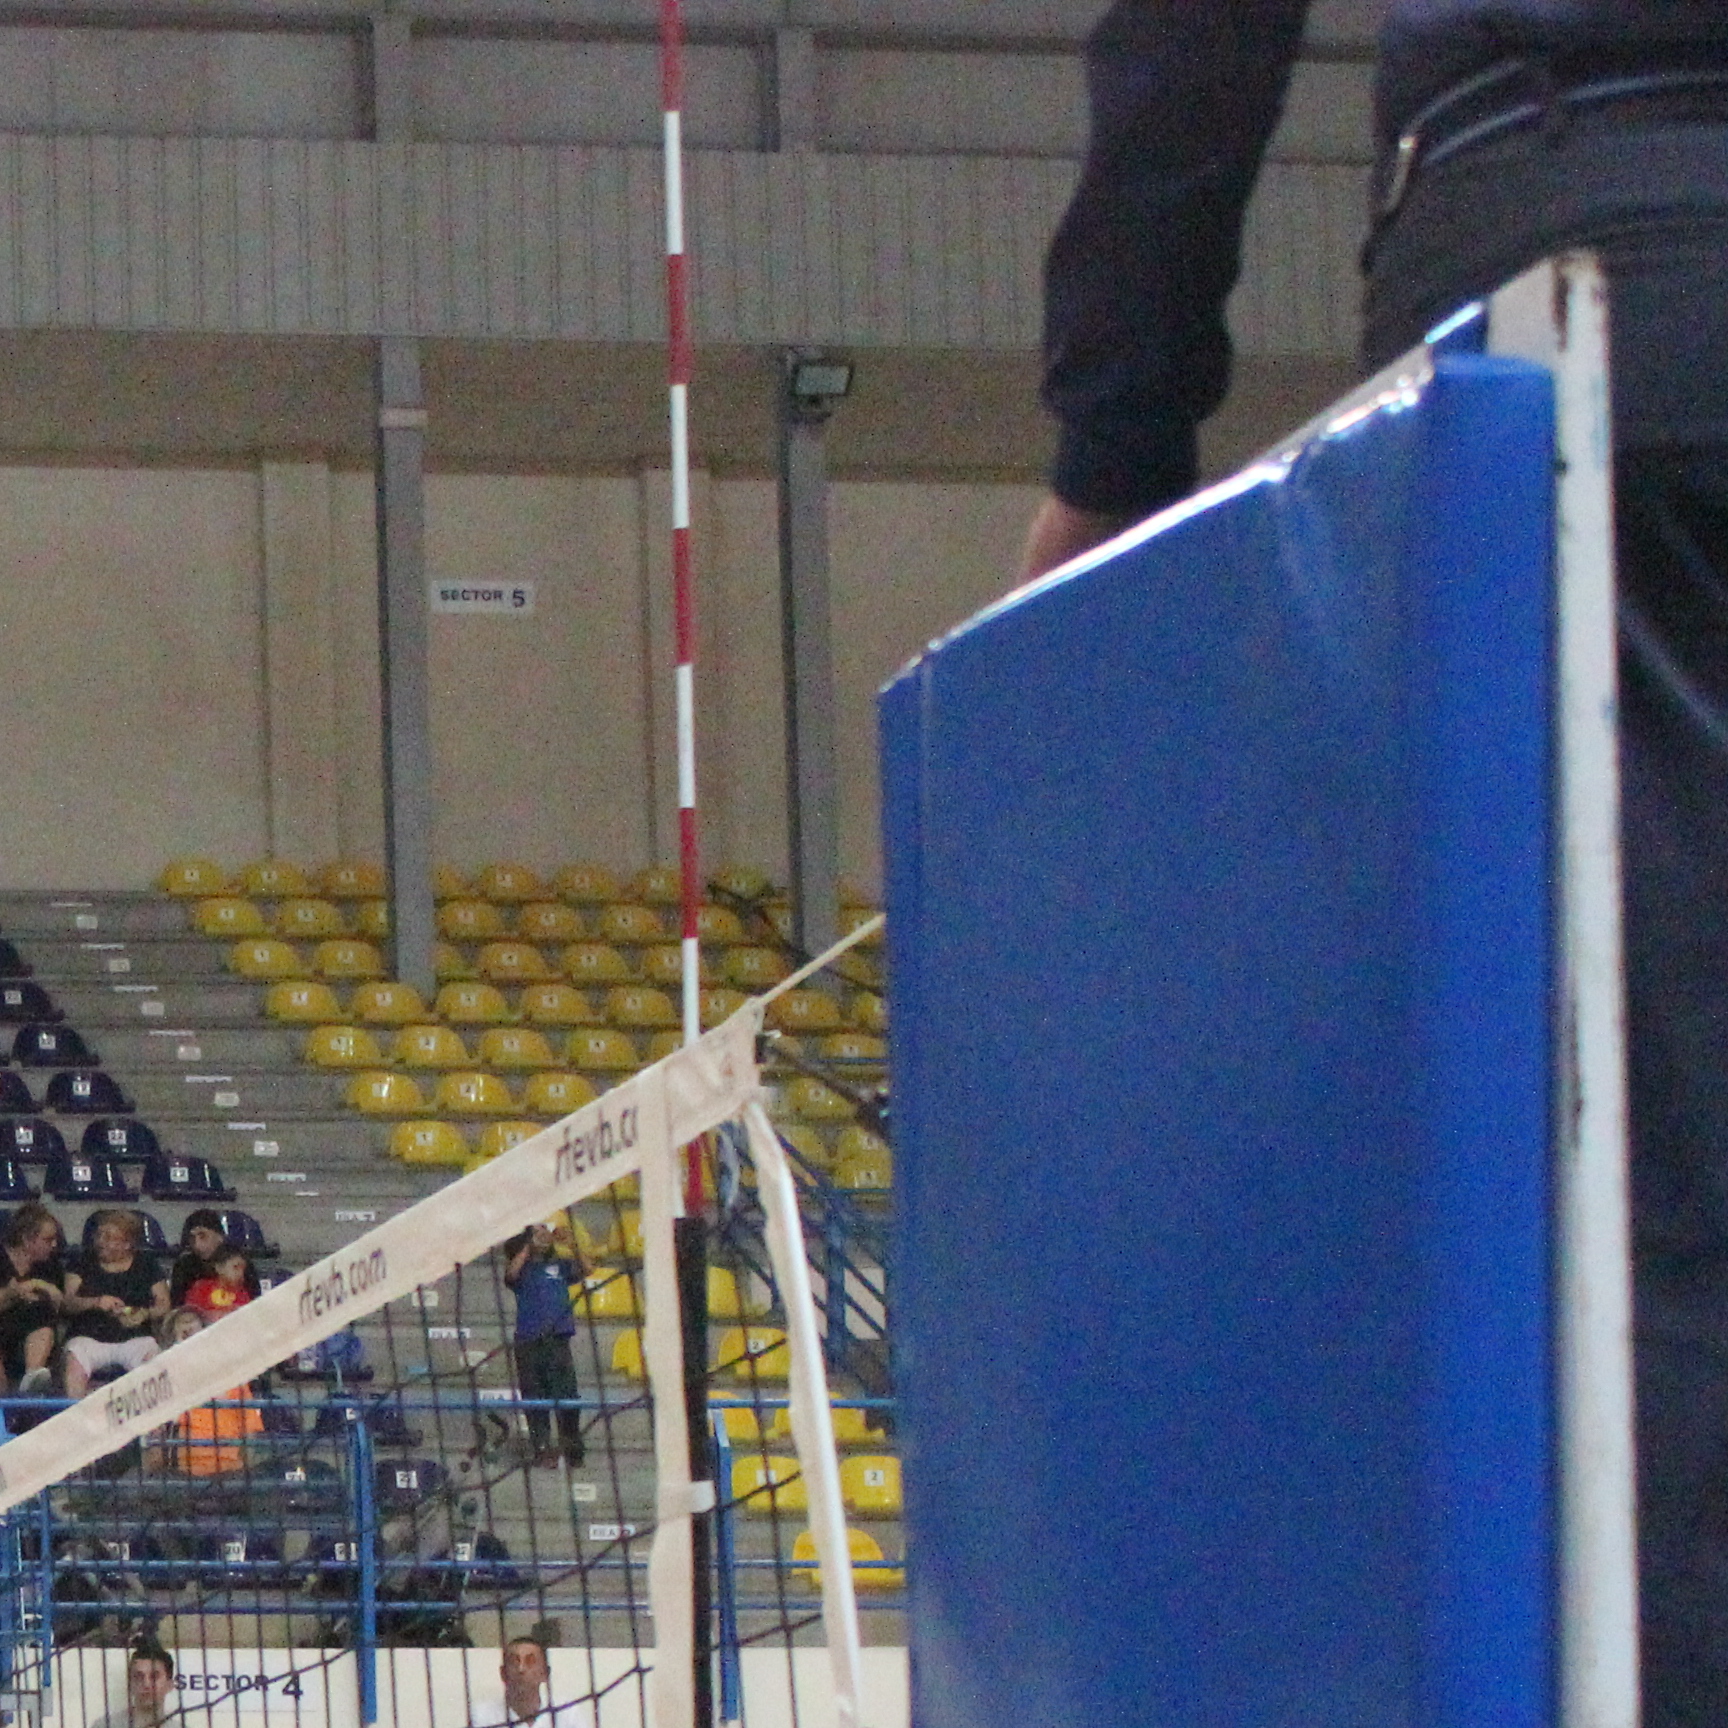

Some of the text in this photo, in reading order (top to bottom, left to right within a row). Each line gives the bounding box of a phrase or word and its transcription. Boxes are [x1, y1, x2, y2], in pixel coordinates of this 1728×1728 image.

[439, 588, 526, 608] SECTOR 5
[299, 1247, 388, 1325] rfevb.com
[105, 1367, 175, 1432] rfevb.com
[174, 1673, 304, 1702] SECTOR 4
